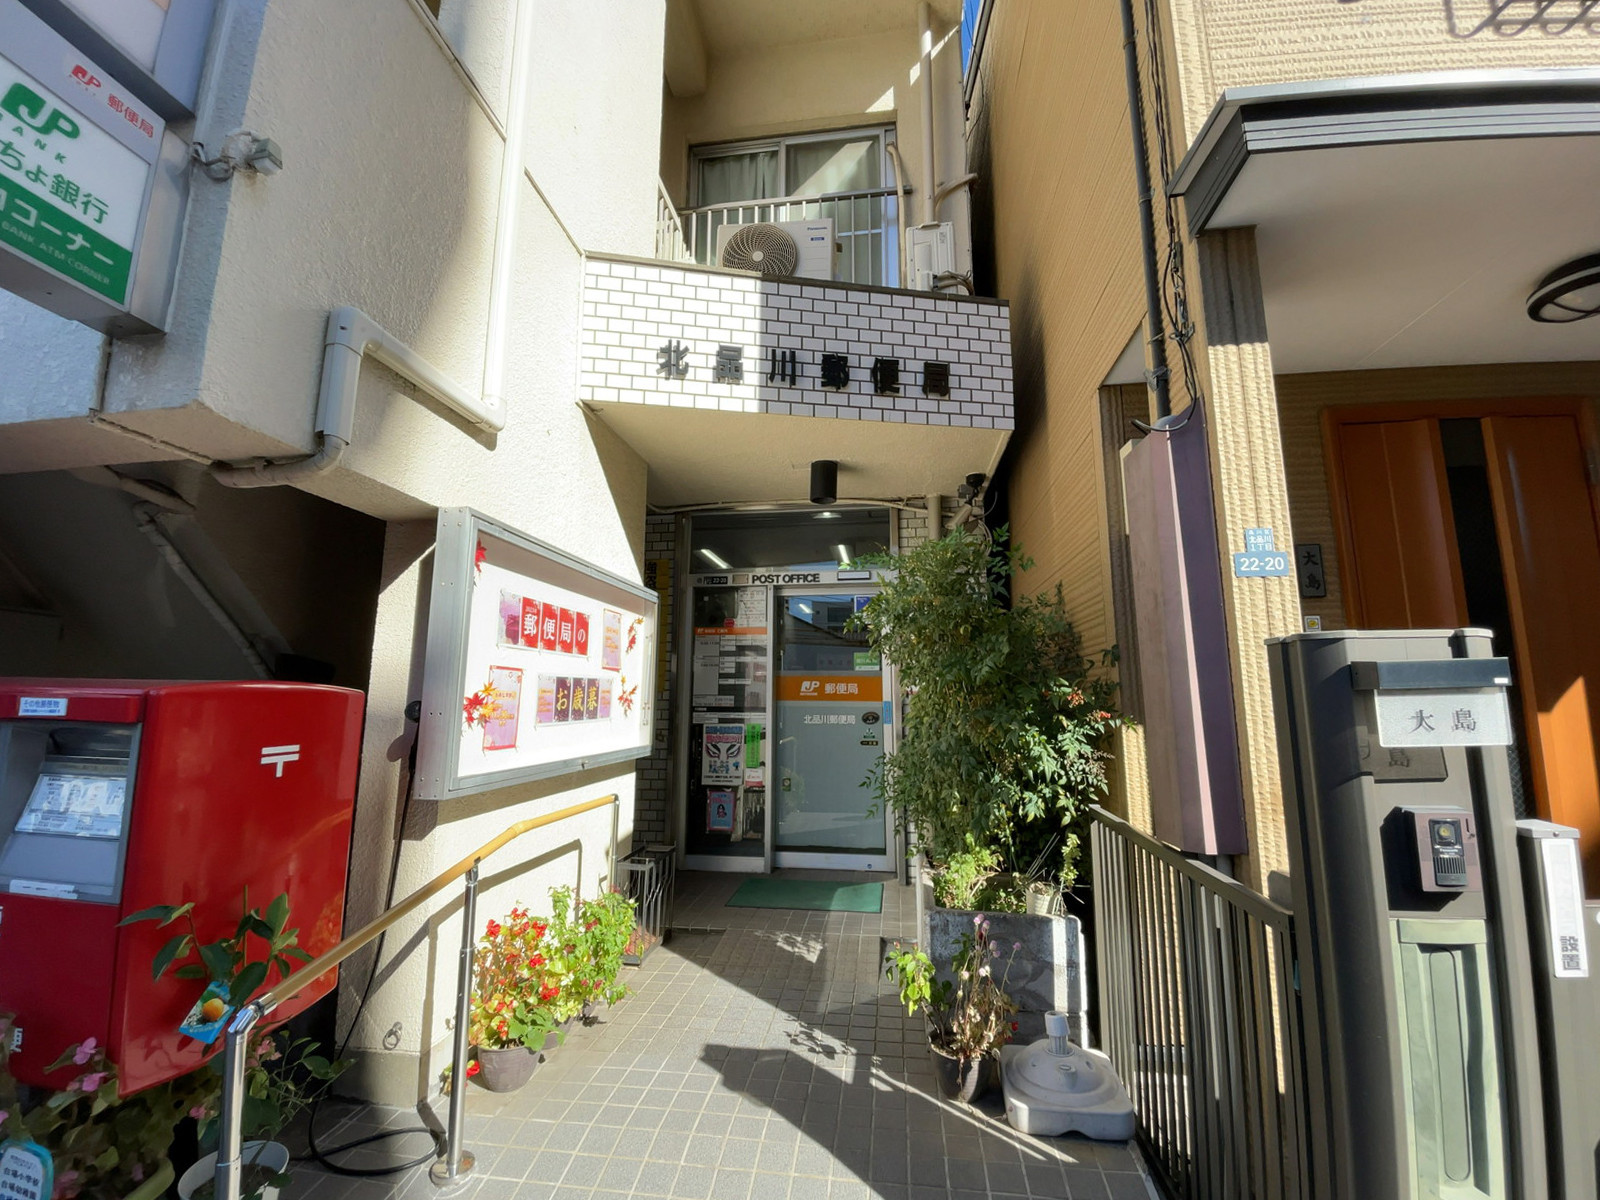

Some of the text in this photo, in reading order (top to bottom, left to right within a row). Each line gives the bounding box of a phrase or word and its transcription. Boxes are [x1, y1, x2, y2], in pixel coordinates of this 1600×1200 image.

[107, 93, 154, 138] 郵便局
[0, 113, 67, 164] ANK
[2, 220, 110, 286] BANK ATM CORNER
[1240, 556, 1285, 571] 22-20
[1302, 551, 1321, 590] 大島
[752, 573, 820, 584] POST OFFICE
[523, 613, 585, 644] 郵便局の
[556, 686, 598, 712] お歳暮
[824, 683, 858, 695] 郵便局
[803, 714, 856, 726] 北品川郵便局
[1409, 708, 1477, 733] 大島
